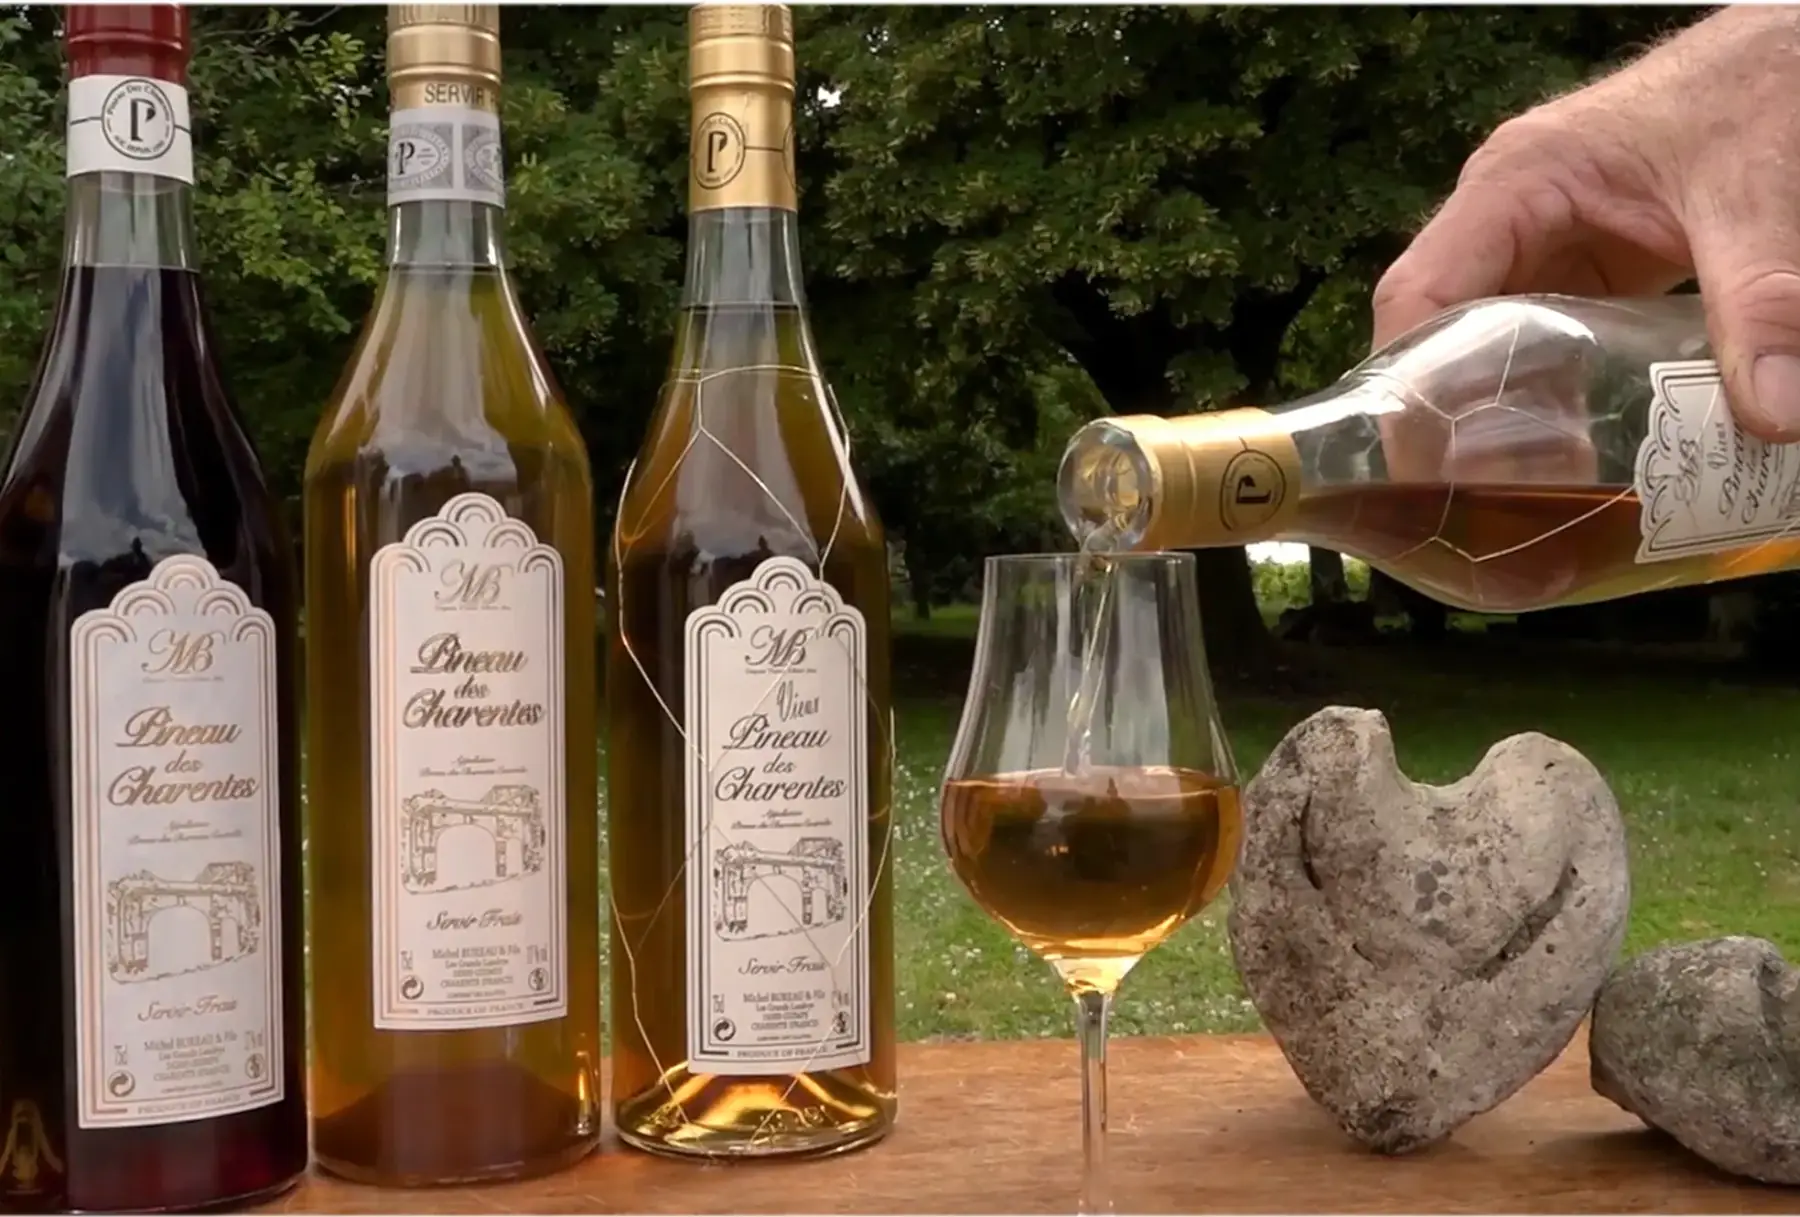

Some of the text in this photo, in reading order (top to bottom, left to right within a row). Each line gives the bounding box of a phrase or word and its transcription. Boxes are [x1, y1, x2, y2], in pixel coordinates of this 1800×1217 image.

[424, 83, 484, 105] SERVIR
[410, 631, 529, 674] Pineau
[453, 673, 490, 700] des
[115, 705, 243, 748] Pineau
[402, 687, 547, 729] Charentes
[721, 712, 832, 750] Pineau
[164, 749, 204, 774] des
[761, 752, 797, 775] des
[106, 765, 260, 807] Charentes
[714, 765, 848, 803] Charentes
